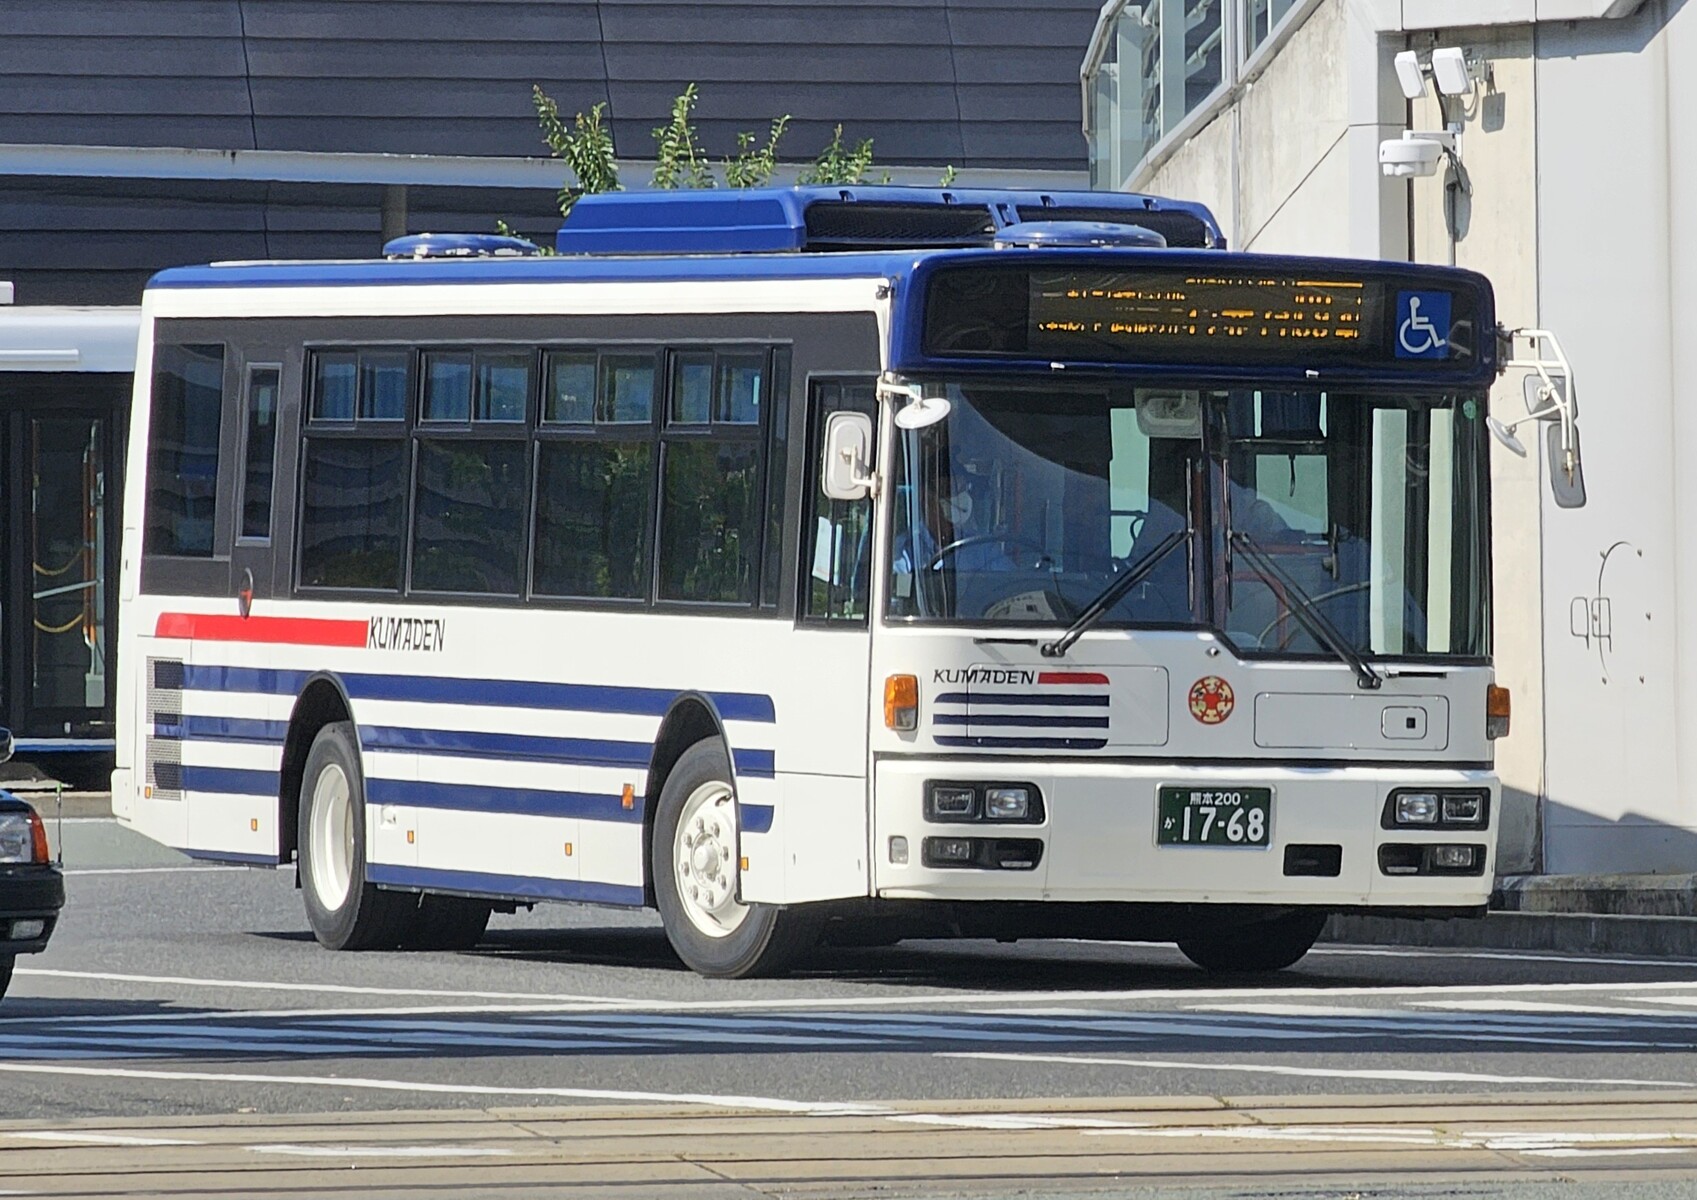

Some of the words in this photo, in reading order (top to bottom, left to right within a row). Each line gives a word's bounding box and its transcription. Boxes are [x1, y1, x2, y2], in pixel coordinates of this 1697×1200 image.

[368, 616, 445, 652] KUMADEN
[933, 669, 1034, 685] KUMADEN
[1182, 806, 1264, 842] 17-68
